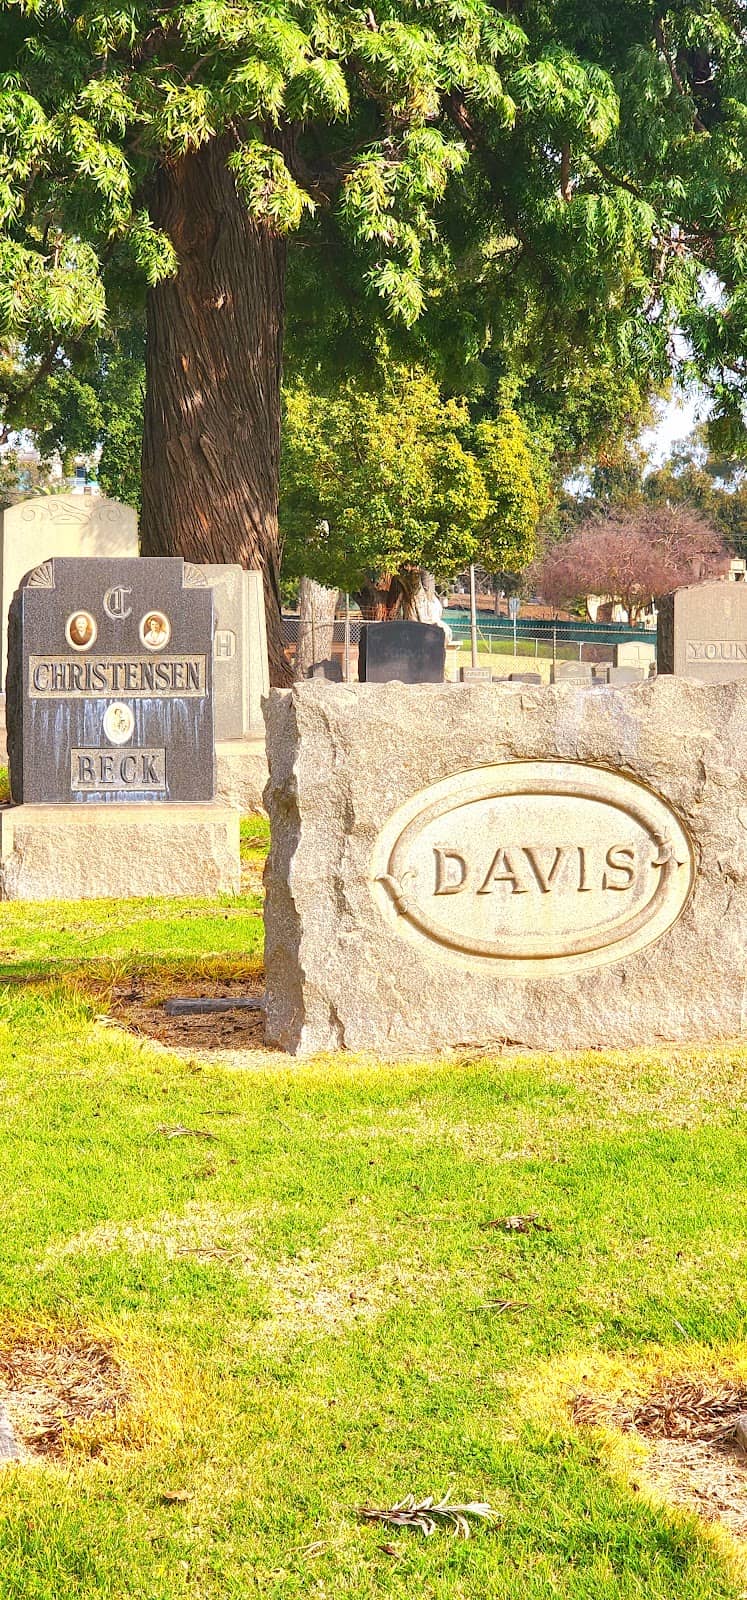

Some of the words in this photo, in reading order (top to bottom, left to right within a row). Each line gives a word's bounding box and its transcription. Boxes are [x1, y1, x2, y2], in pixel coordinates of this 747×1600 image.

[33, 661, 200, 692] CHRISTENSEN
[78, 754, 160, 784] BECK
[432, 844, 635, 896] DAVIS
